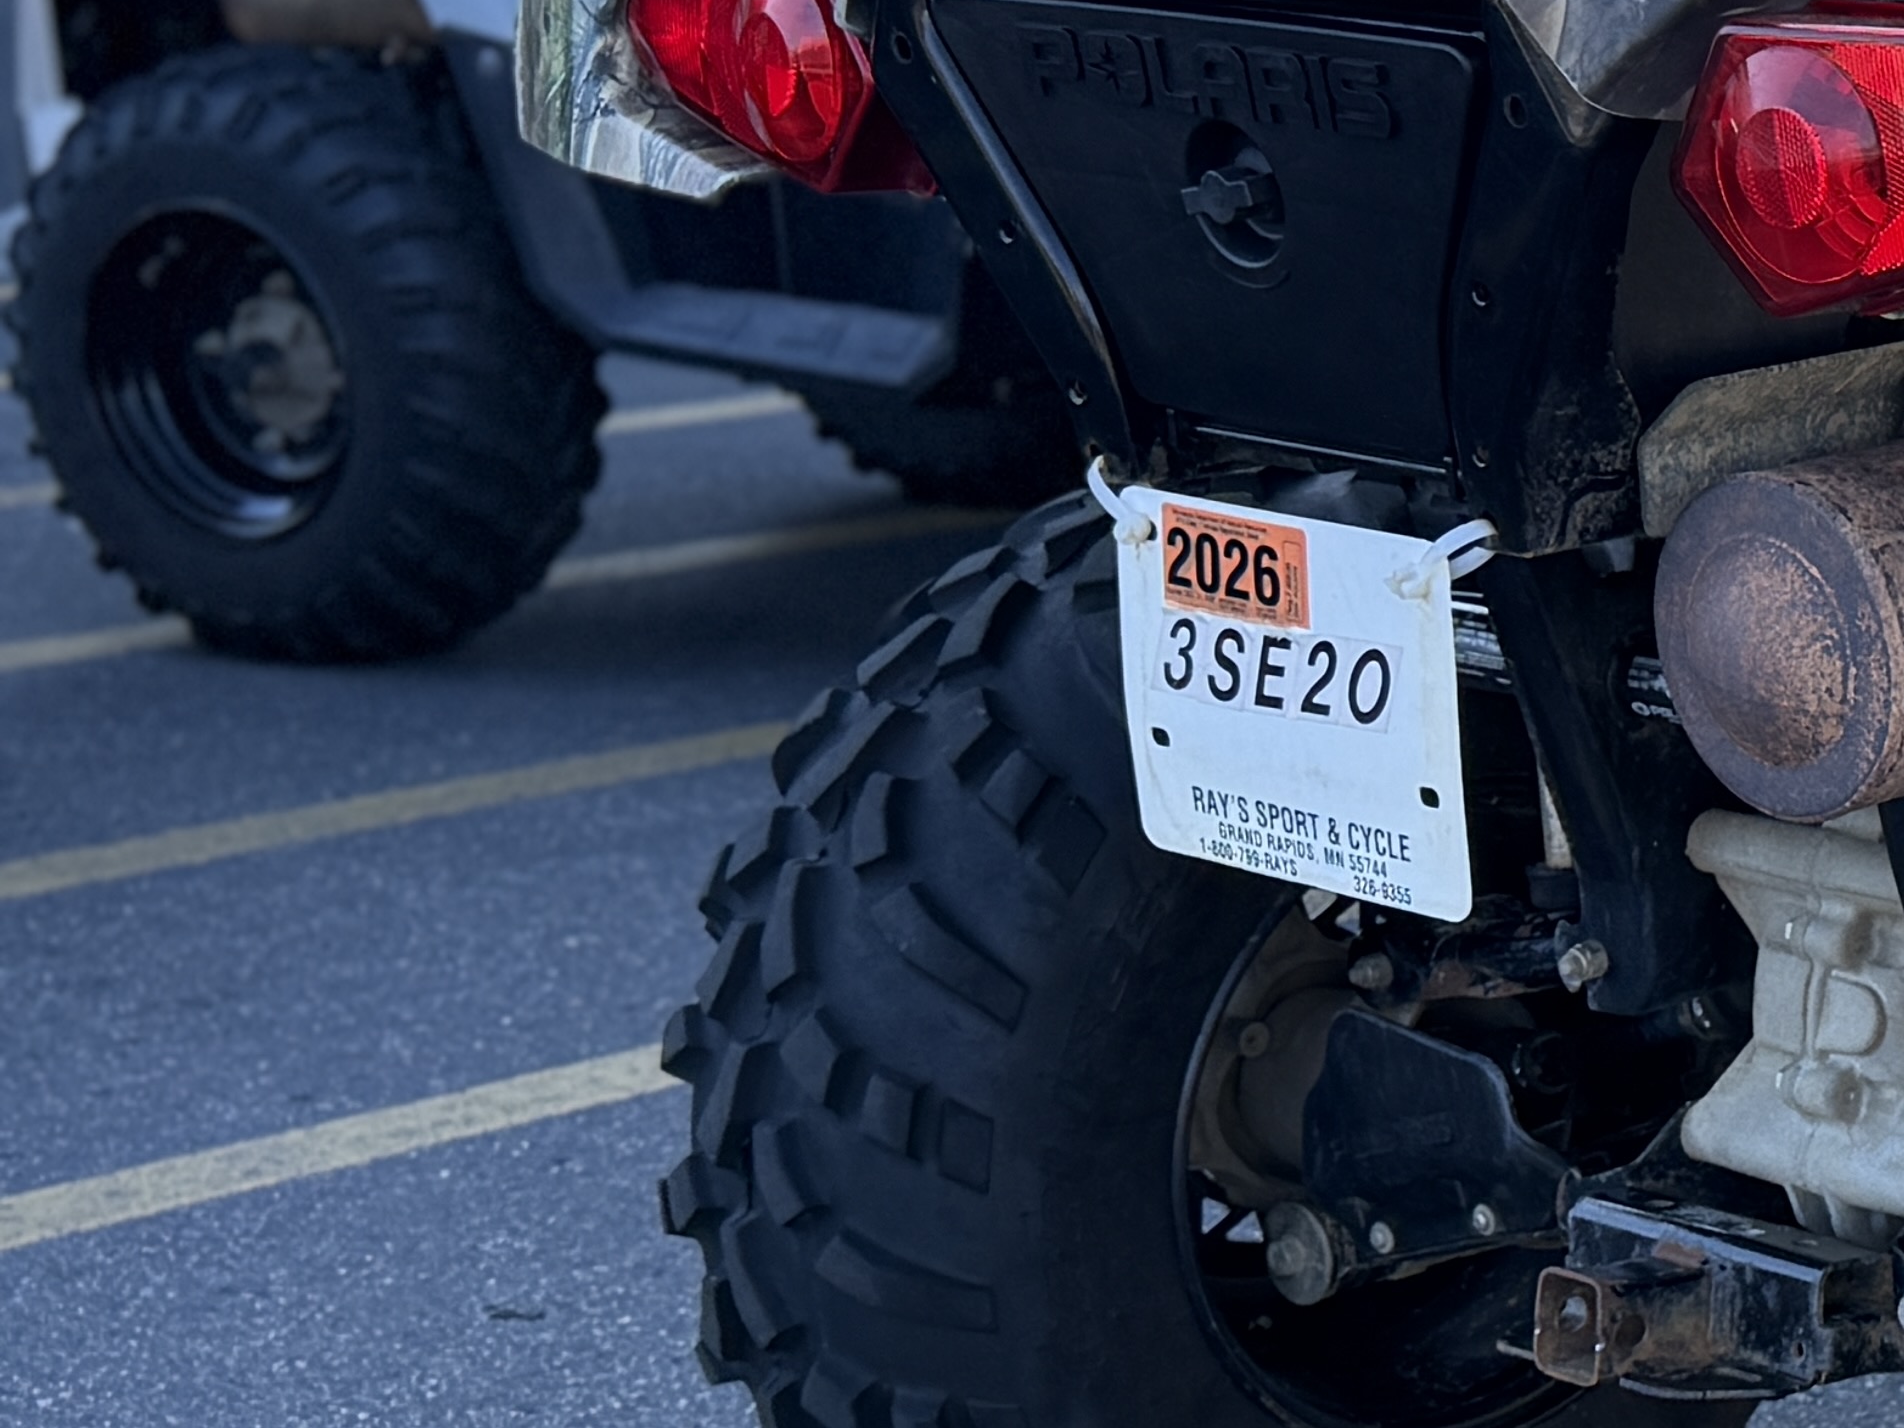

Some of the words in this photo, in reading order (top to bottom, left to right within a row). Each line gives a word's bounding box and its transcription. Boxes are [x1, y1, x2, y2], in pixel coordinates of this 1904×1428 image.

[1014, 22, 1401, 140] POLARIS
[1167, 526, 1281, 607] 2026
[1192, 785, 1250, 823] RAY'S
[1255, 800, 1320, 841] SPORT
[1328, 817, 1341, 847] &
[1348, 822, 1412, 863] CYCLE
[1218, 821, 1263, 848] GRAND
[1349, 853, 1388, 879] 55744
